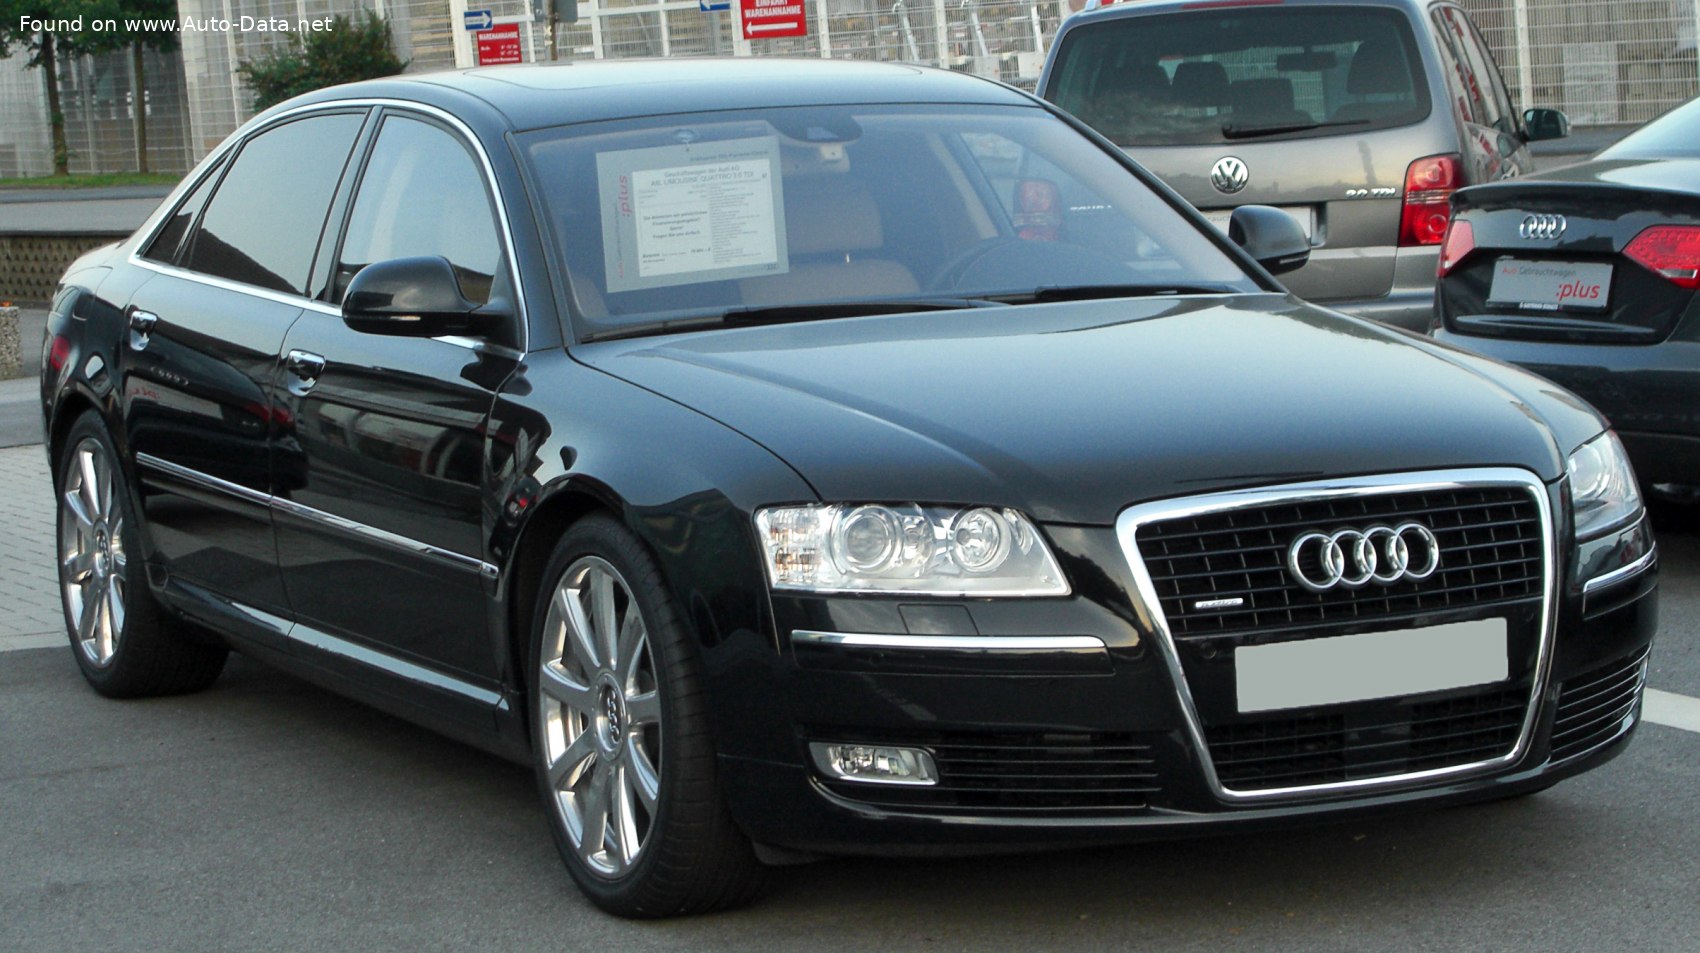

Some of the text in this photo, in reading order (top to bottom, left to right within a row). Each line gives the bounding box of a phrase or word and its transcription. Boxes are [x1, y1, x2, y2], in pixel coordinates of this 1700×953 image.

[744, 5, 801, 18] WARENANNAHME
[618, 175, 632, 217] :plus
[1555, 280, 1601, 302] :plus
